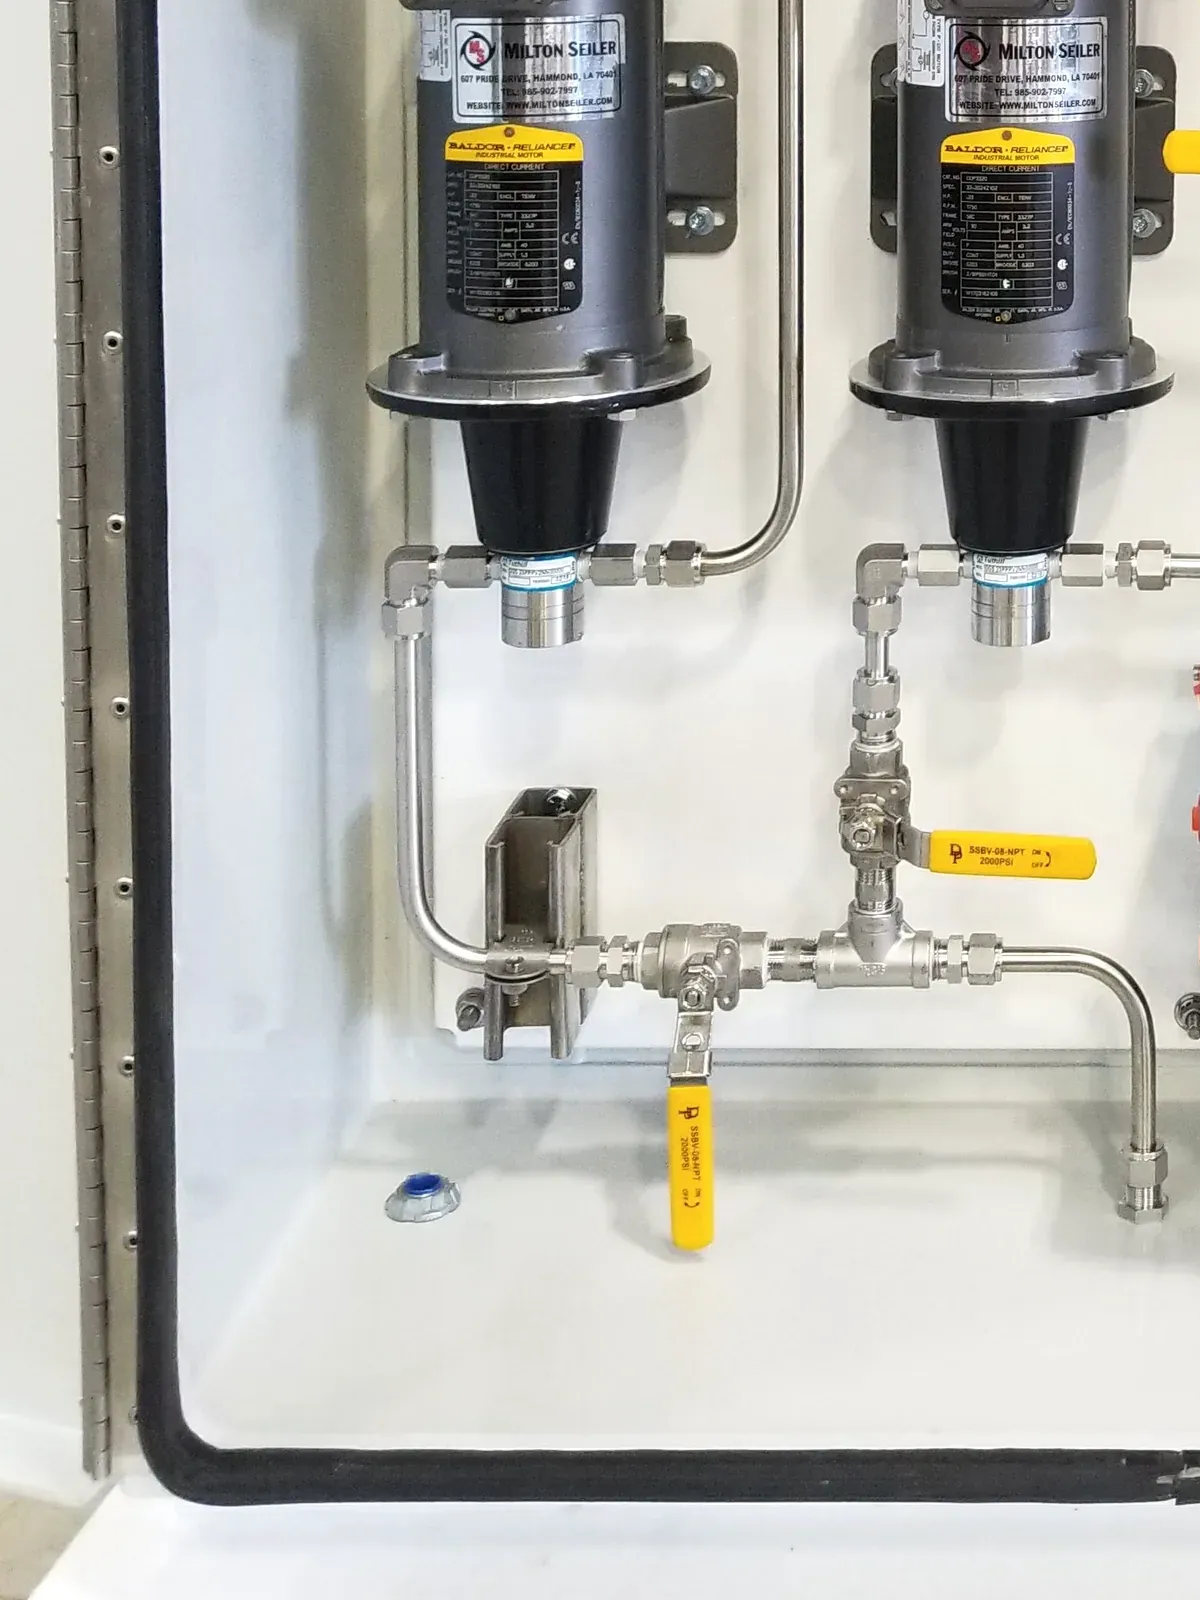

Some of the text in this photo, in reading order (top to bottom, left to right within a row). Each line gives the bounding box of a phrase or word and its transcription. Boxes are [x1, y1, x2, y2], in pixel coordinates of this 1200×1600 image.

[504, 41, 617, 59] MILTON SEILER
[999, 43, 1100, 59] MILTON SEILER
[476, 75, 499, 83] PRIDE
[502, 75, 531, 84] DRIVE,
[533, 73, 581, 83] HAMMOND,
[583, 72, 594, 80] LA
[596, 71, 617, 79] 70401
[969, 75, 994, 83] PRIDE
[996, 75, 1024, 84] DRIVE,
[1026, 74, 1070, 83] HAMMOND,
[1071, 73, 1081, 81] LA
[1082, 72, 1100, 80] 70401
[501, 88, 520, 96] TEL:
[1014, 87, 1066, 96] 985-902-7997
[506, 97, 613, 110] WWW.MILTONSEILER.COM
[1000, 99, 1096, 110] WWW.MILTONSEILER.COM
[448, 142, 505, 151] BALDOR
[944, 145, 1003, 153] BALDOR
[969, 846, 1025, 856] SSBV-08-NPT
[980, 857, 1013, 866] 2000PSI
[690, 1126, 701, 1181] SSBV-08-NPT
